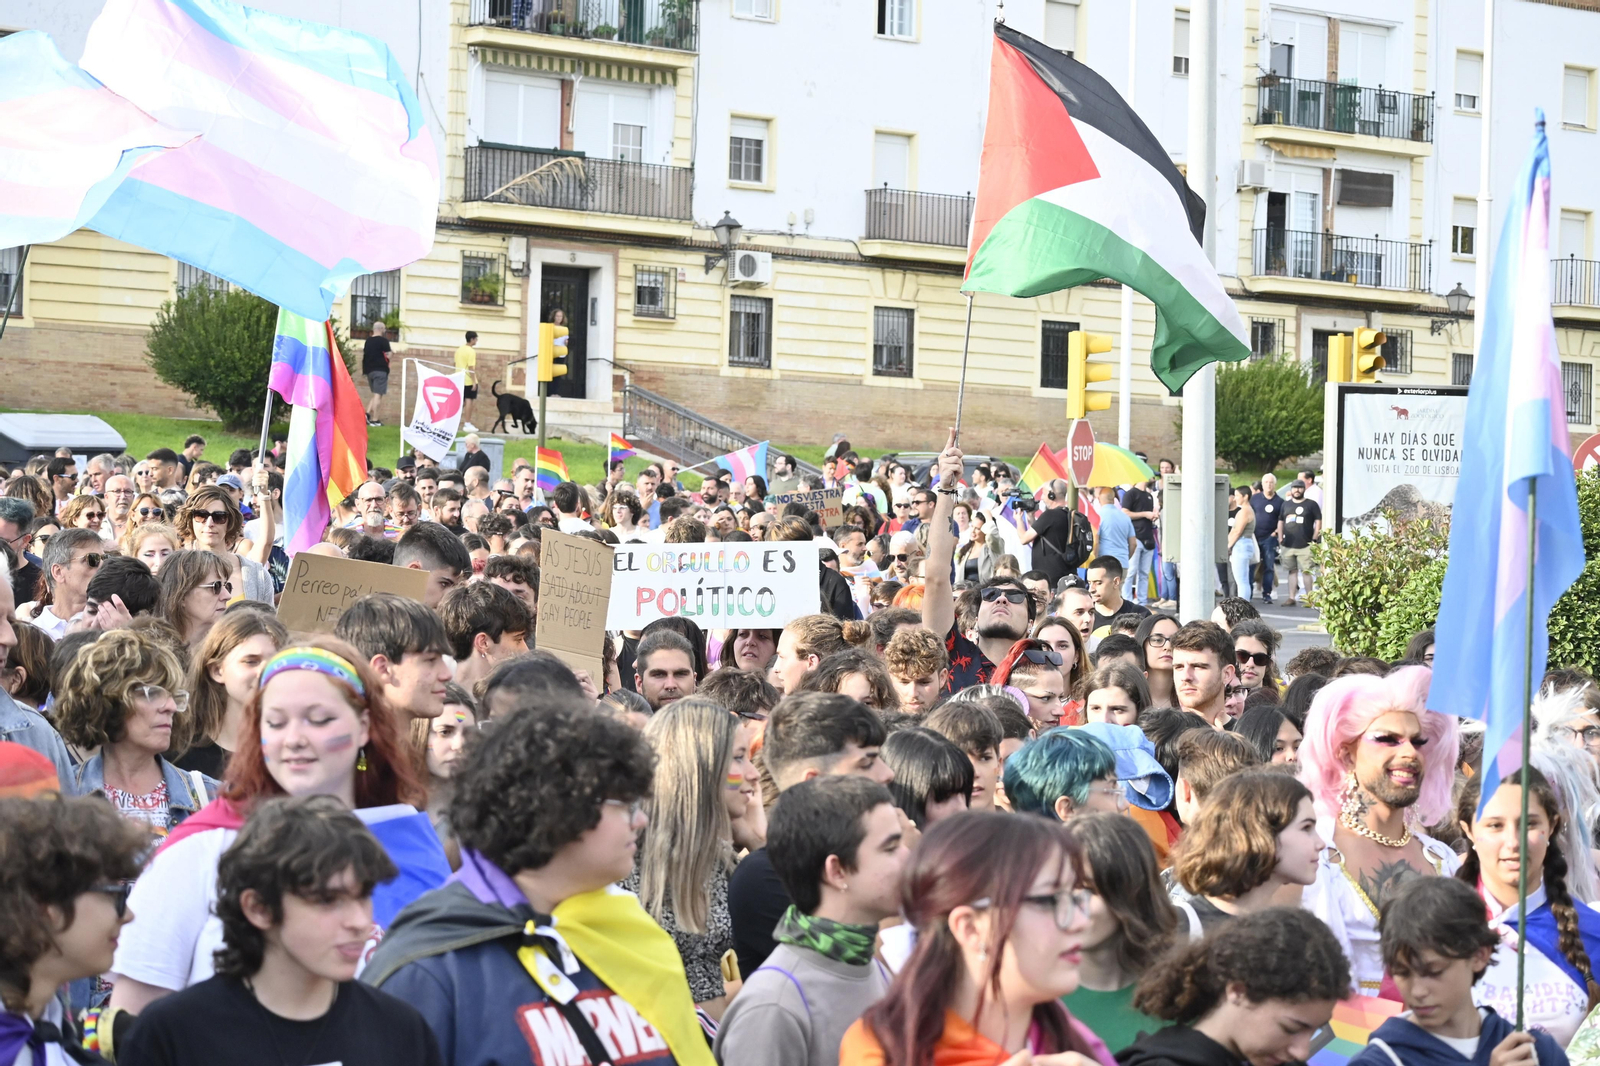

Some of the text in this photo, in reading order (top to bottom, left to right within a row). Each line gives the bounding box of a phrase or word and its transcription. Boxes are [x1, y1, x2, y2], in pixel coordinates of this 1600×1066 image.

[1374, 430, 1455, 447] HAY DÍAS QUE
[1073, 445, 1093, 461] STOP
[1358, 447, 1463, 462] NUNCA SE OLVIDA
[1366, 463, 1459, 475] VISITA EL ZOO DE LISBOA
[544, 540, 602, 576] AS JESUS
[613, 550, 796, 573] EL ORGULLO ES
[292, 560, 340, 595] Perreo
[543, 573, 602, 606] SAID ABOUT
[636, 577, 775, 617] POLÍTICO
[541, 602, 592, 629] GAY PEOPLE
